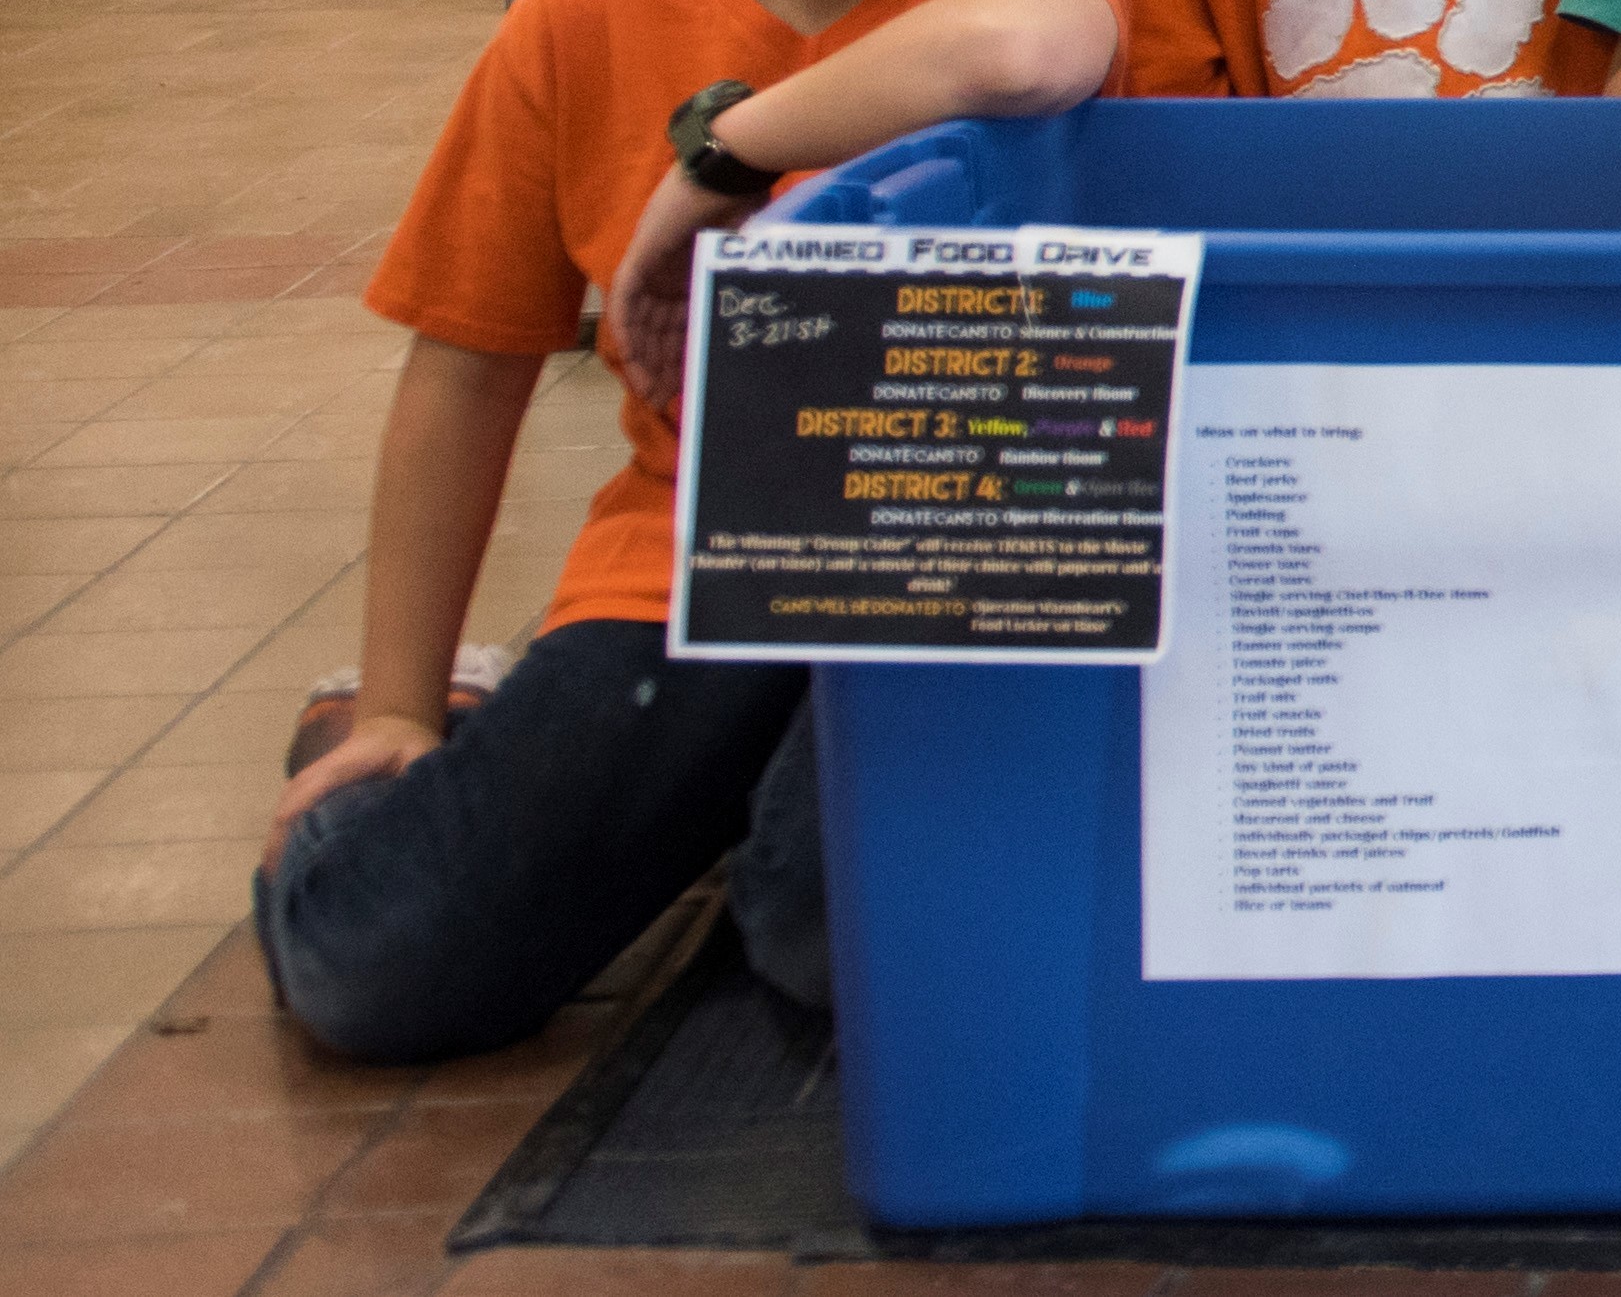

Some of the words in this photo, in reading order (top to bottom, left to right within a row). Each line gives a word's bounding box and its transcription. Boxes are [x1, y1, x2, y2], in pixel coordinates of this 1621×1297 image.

[716, 235, 885, 262] CANNED
[908, 237, 1015, 265] FOOD
[1036, 242, 1153, 267] DRIVE
[897, 287, 1020, 315] DISTRICT
[1071, 290, 1115, 310] Blue
[881, 323, 945, 339] DONATE
[949, 324, 989, 339] CANS
[992, 324, 1012, 339] TO
[1075, 326, 1085, 340] &
[884, 348, 1012, 376] DISTRICT
[1015, 349, 1039, 377] 2:
[872, 384, 937, 400] DONATE
[981, 386, 1002, 401] TO
[1022, 386, 1089, 404] Discovery
[797, 409, 928, 438] DISTRICT
[933, 410, 960, 439] 3:
[1099, 419, 1115, 438] &
[849, 445, 912, 463] DONATE
[957, 449, 978, 464] TO
[844, 473, 971, 500] DISTRICT
[975, 474, 1003, 501] 4:
[1065, 478, 1081, 496] &
[870, 510, 932, 526] DONATE
[976, 511, 998, 527] TO
